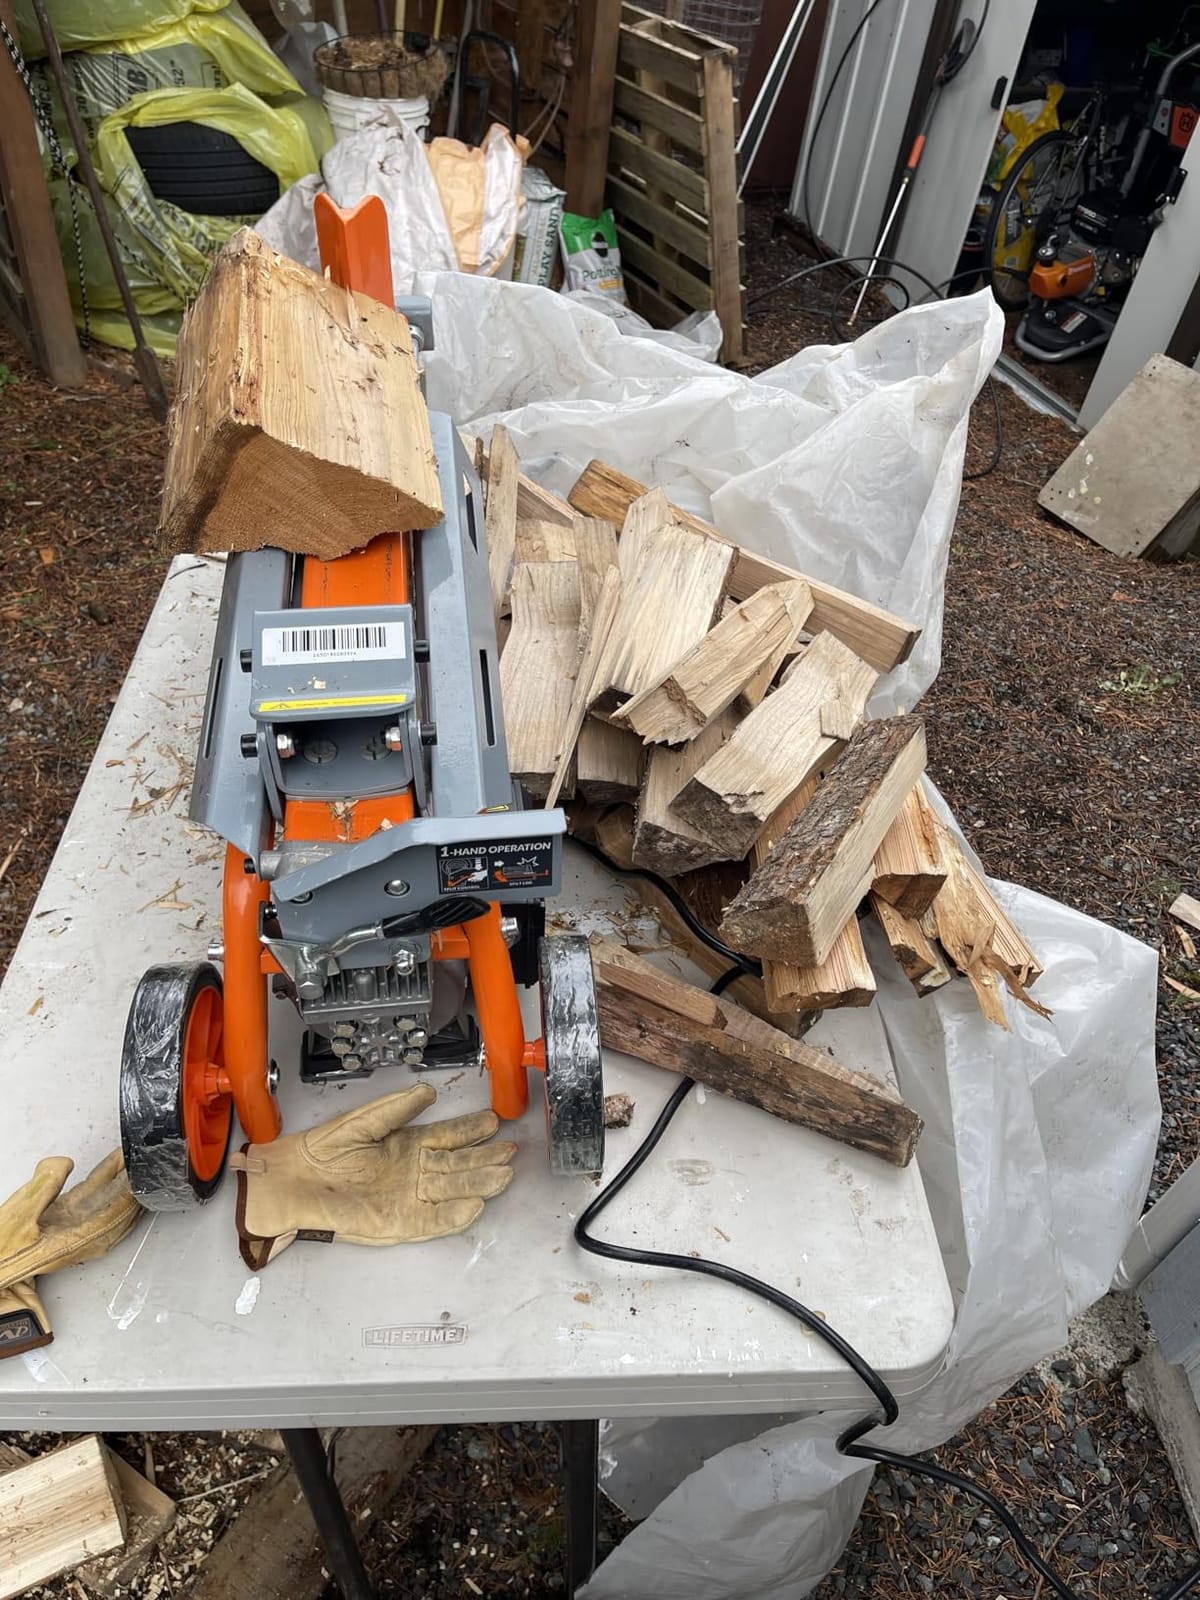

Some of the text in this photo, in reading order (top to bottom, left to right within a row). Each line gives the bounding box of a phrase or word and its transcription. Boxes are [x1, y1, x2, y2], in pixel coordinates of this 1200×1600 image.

[537, 251, 552, 286] PLAY
[545, 207, 560, 247] SAND
[582, 265, 619, 282] Potting
[440, 842, 551, 858] 1-HAND OPERATION
[373, 1328, 457, 1344] LIFETIME
